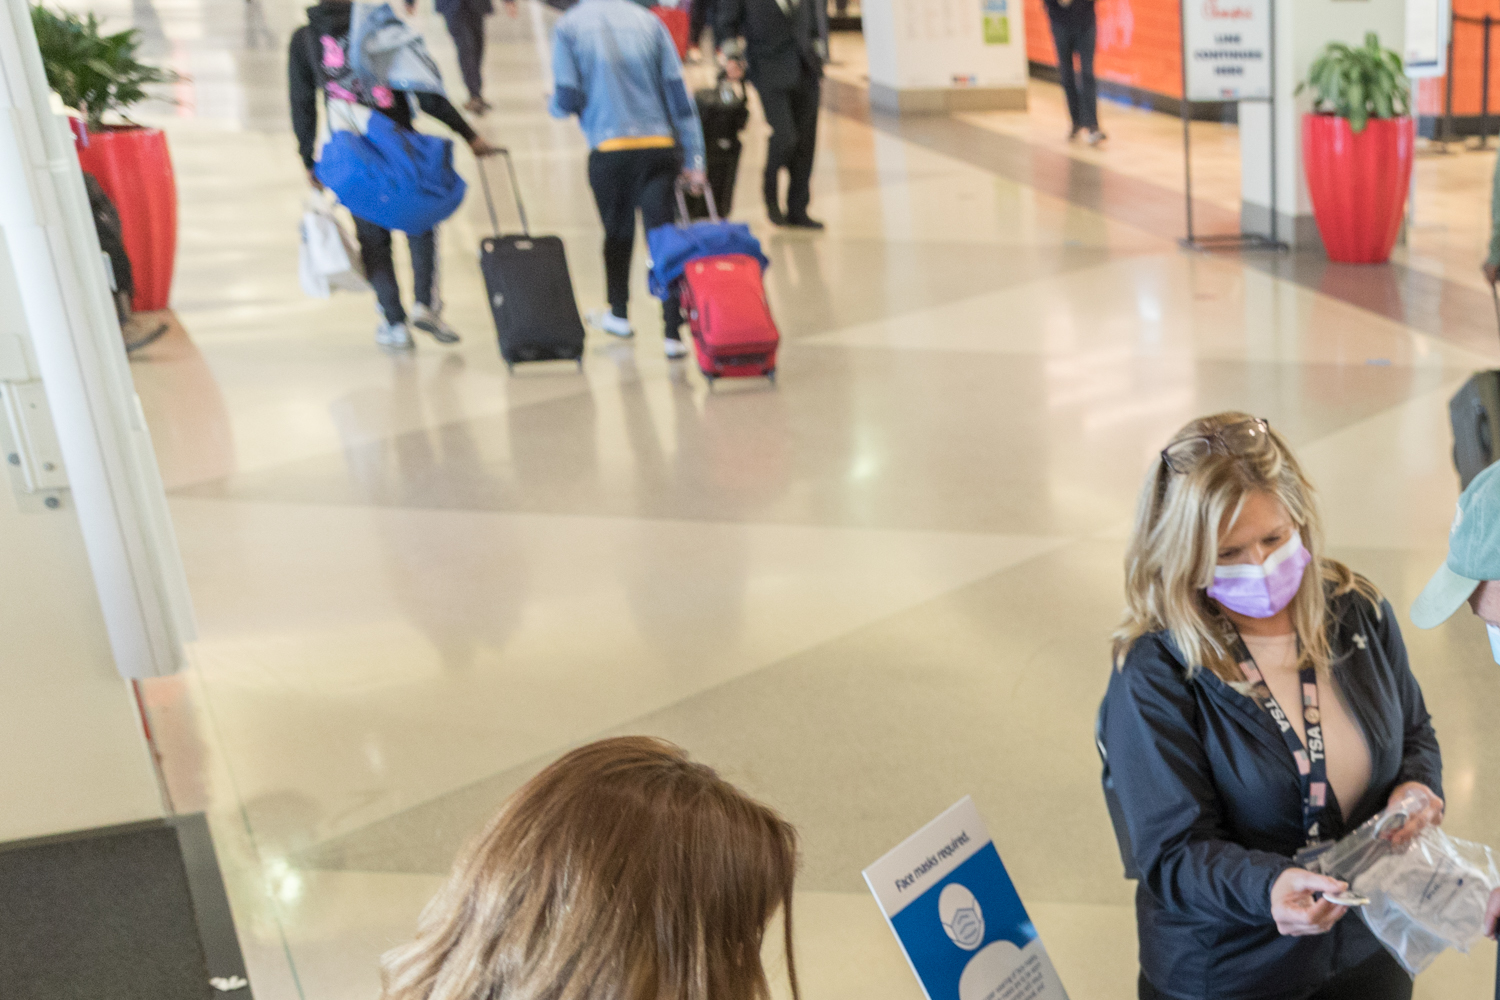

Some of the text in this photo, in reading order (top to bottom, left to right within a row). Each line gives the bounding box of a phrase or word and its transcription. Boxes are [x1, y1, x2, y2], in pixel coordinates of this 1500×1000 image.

[1265, 699, 1291, 733] TSA
[1308, 726, 1325, 763] TSA
[893, 871, 915, 892] Face
[910, 853, 939, 878] masks
